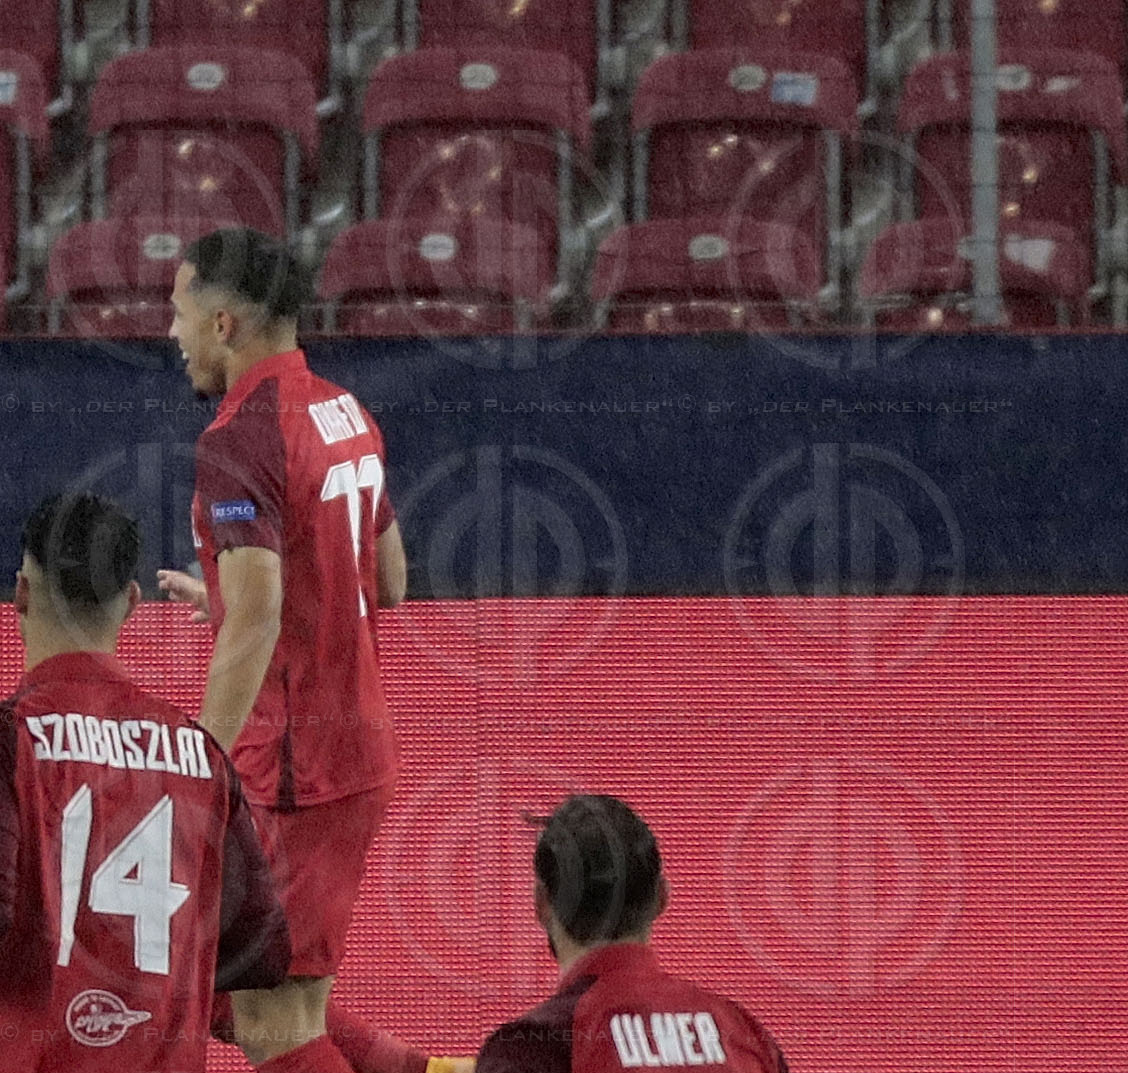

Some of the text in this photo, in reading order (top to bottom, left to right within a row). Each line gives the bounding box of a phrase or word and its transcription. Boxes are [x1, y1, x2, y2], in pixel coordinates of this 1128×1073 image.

[25, 713, 212, 779] SZOBOSZLAI
[56, 783, 191, 976] 14
[609, 1011, 726, 1067] ULMER
